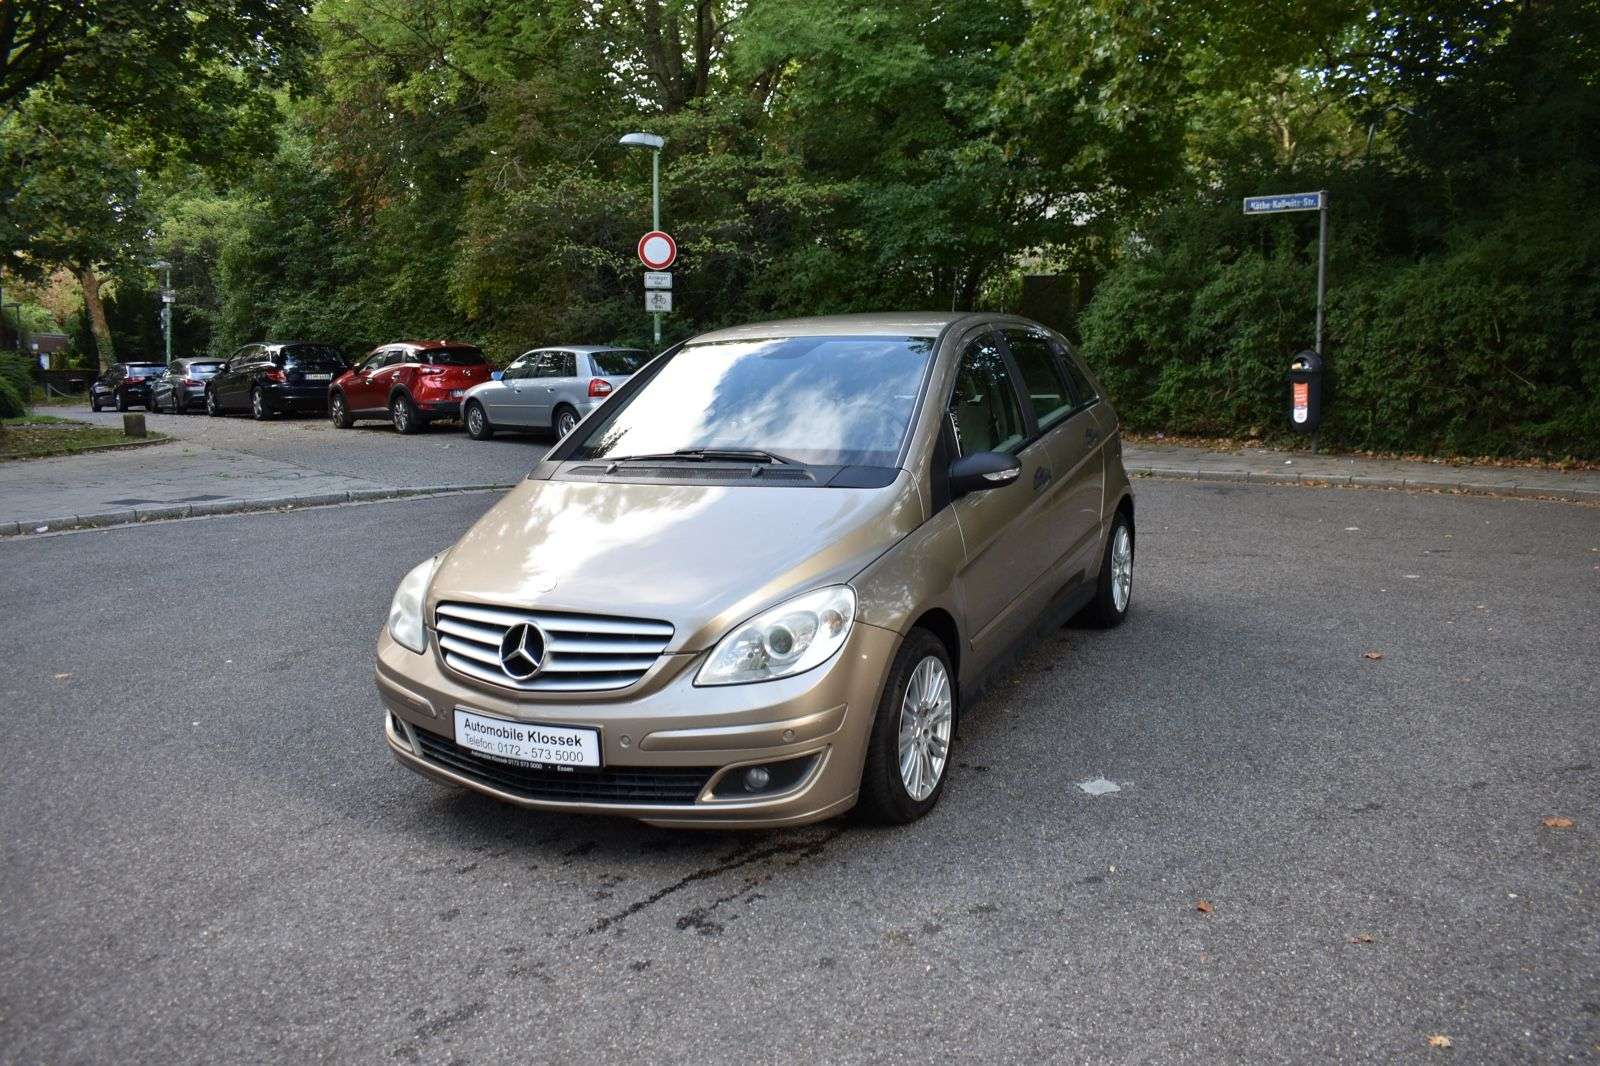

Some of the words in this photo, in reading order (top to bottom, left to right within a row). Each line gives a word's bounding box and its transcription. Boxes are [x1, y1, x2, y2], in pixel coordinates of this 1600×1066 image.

[464, 717, 524, 741] Automobile
[527, 730, 582, 747] Klossek
[464, 733, 496, 751] Telefon:
[497, 742, 521, 756] 0172
[531, 747, 552, 760] 573
[555, 750, 584, 762] 5000
